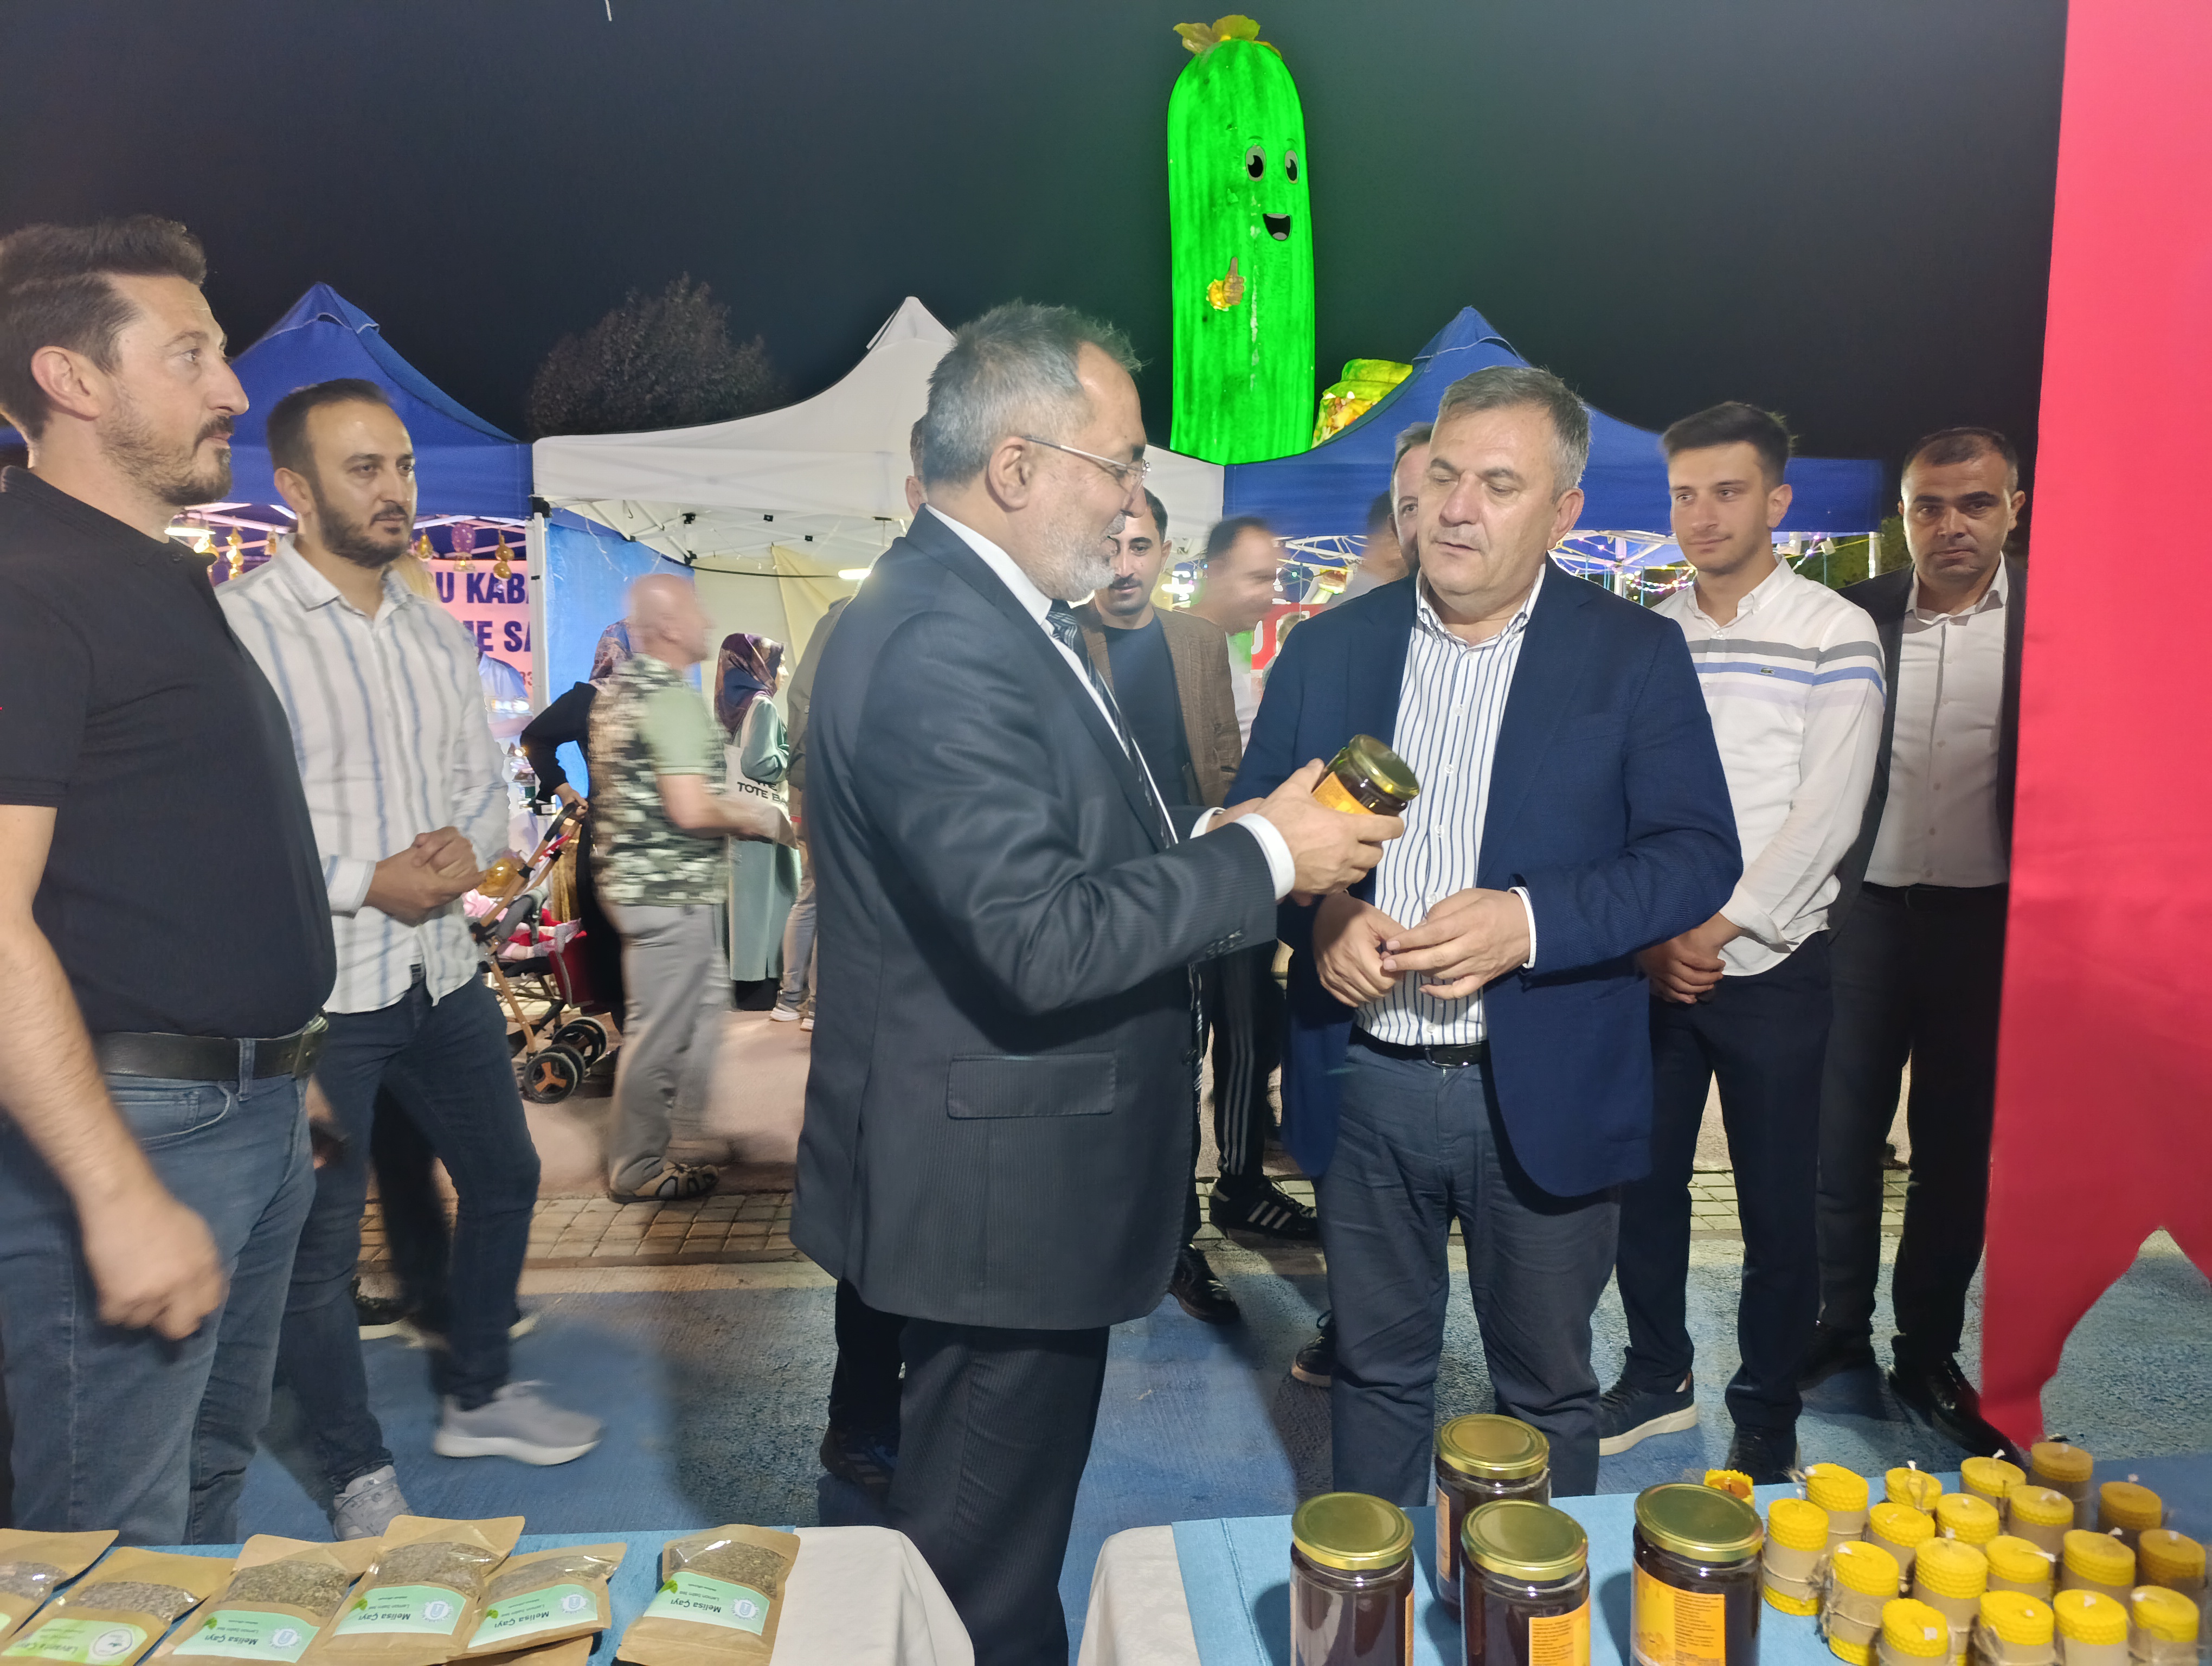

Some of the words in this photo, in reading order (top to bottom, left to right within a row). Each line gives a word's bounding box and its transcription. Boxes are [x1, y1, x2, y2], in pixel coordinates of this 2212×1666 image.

[435, 571, 455, 604] U
[466, 572, 529, 604] KAB
[462, 620, 493, 652] E
[737, 781, 768, 799] TOTE
[772, 792, 788, 806] BA
[670, 1598, 690, 1608] Çayı
[692, 1602, 722, 1613] Melisa
[494, 1617, 516, 1629] Çayı
[518, 1611, 549, 1623] Melisa
[228, 1636, 259, 1645] Melisa
